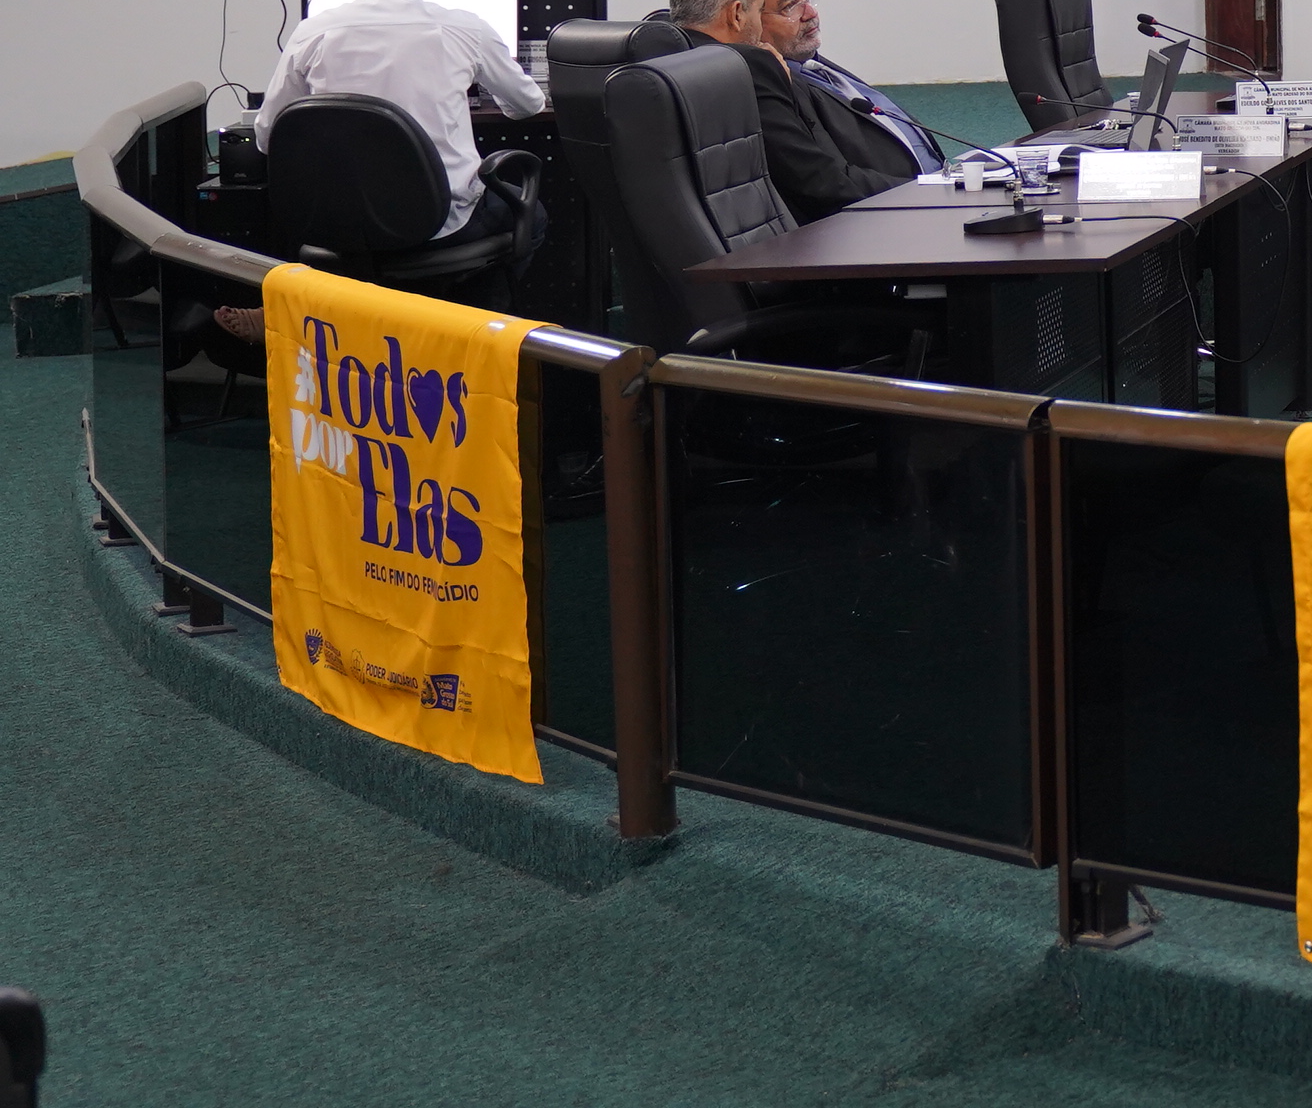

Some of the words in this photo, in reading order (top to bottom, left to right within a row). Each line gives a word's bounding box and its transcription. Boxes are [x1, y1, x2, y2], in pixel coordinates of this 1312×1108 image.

[290, 407, 354, 474] por
[353, 433, 484, 567] Elas
[365, 561, 386, 582] PELO
[389, 569, 405, 587] FIM
[407, 573, 420, 591] DO
